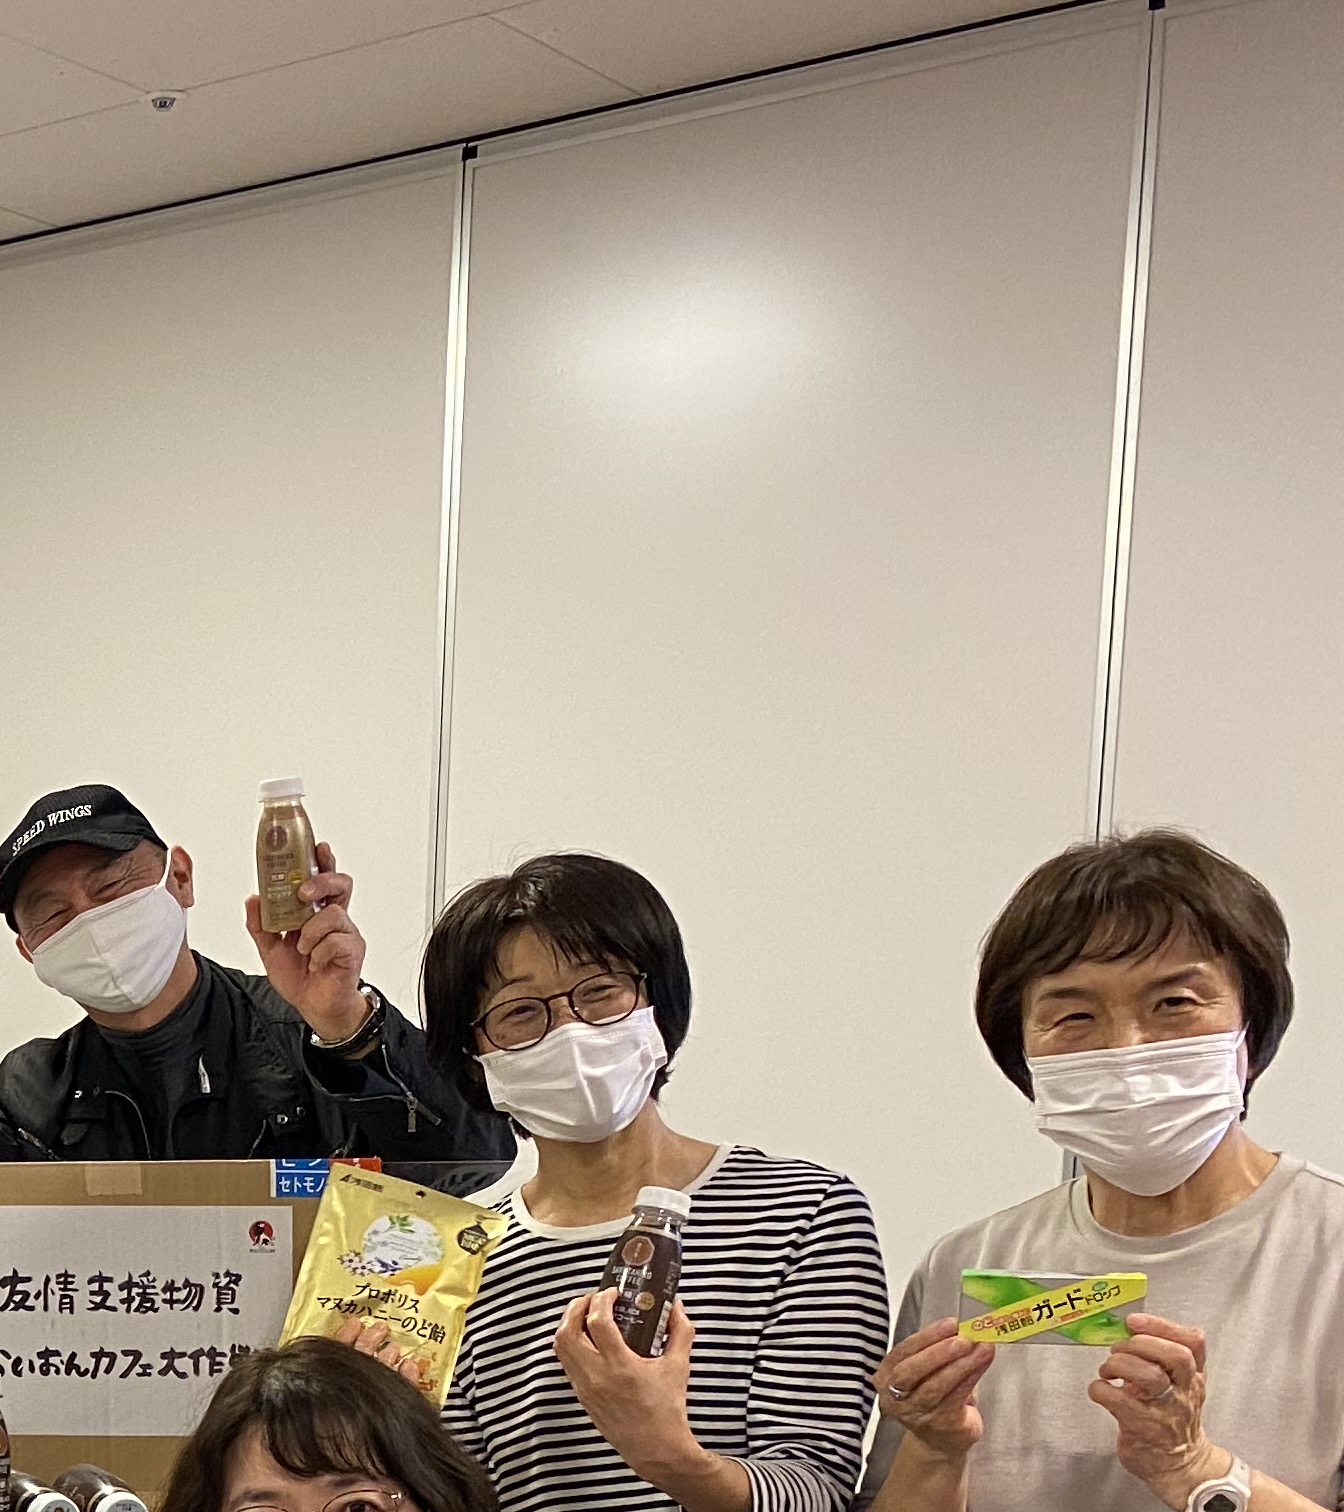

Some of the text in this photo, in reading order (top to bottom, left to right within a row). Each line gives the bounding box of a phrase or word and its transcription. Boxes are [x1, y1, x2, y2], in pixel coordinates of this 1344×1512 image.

[12, 805, 92, 857] SPEED WINGS
[317, 1295, 446, 1344] マヌカハニーのど飴
[355, 1283, 420, 1313] プロポリス
